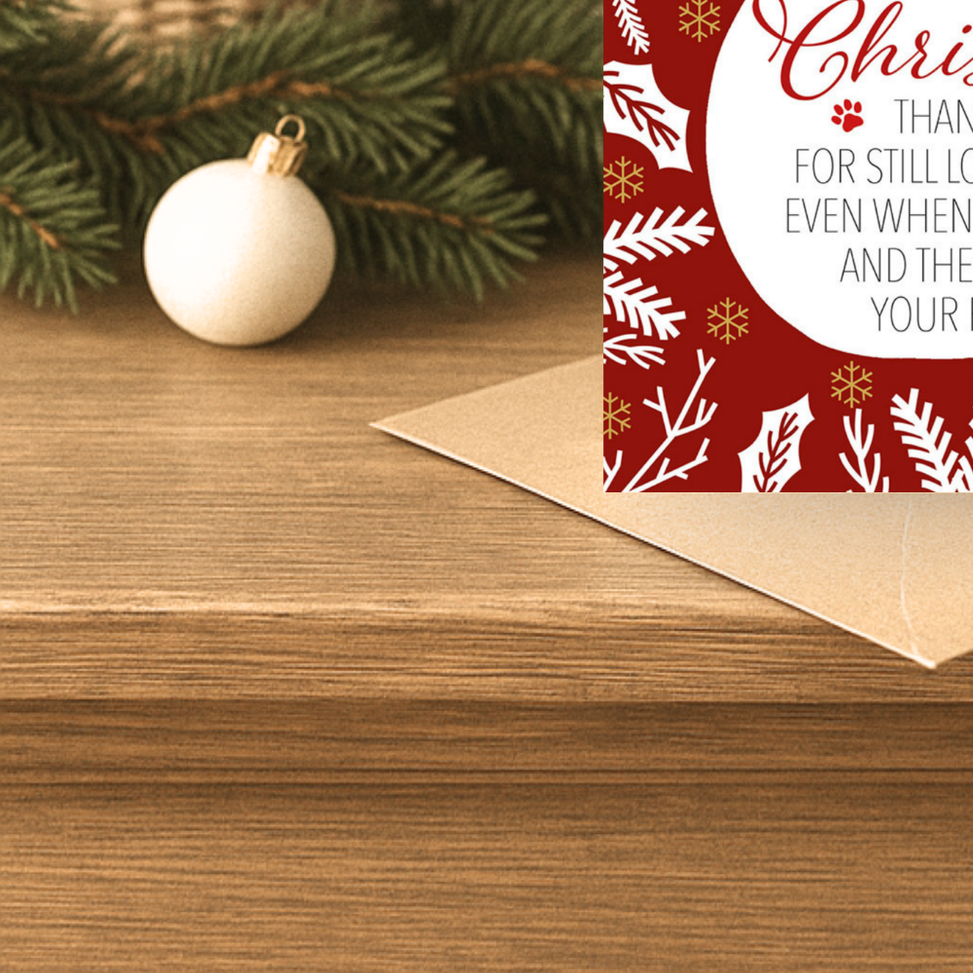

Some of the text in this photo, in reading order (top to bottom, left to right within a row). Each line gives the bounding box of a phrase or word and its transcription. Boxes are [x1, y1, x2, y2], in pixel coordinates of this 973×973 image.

[796, 148, 855, 184] FOR
[867, 148, 938, 184] STILL
[787, 198, 861, 233] EVEN
[873, 198, 971, 233] WHEN
[840, 247, 907, 282] AND
[871, 296, 958, 332] YOUR
